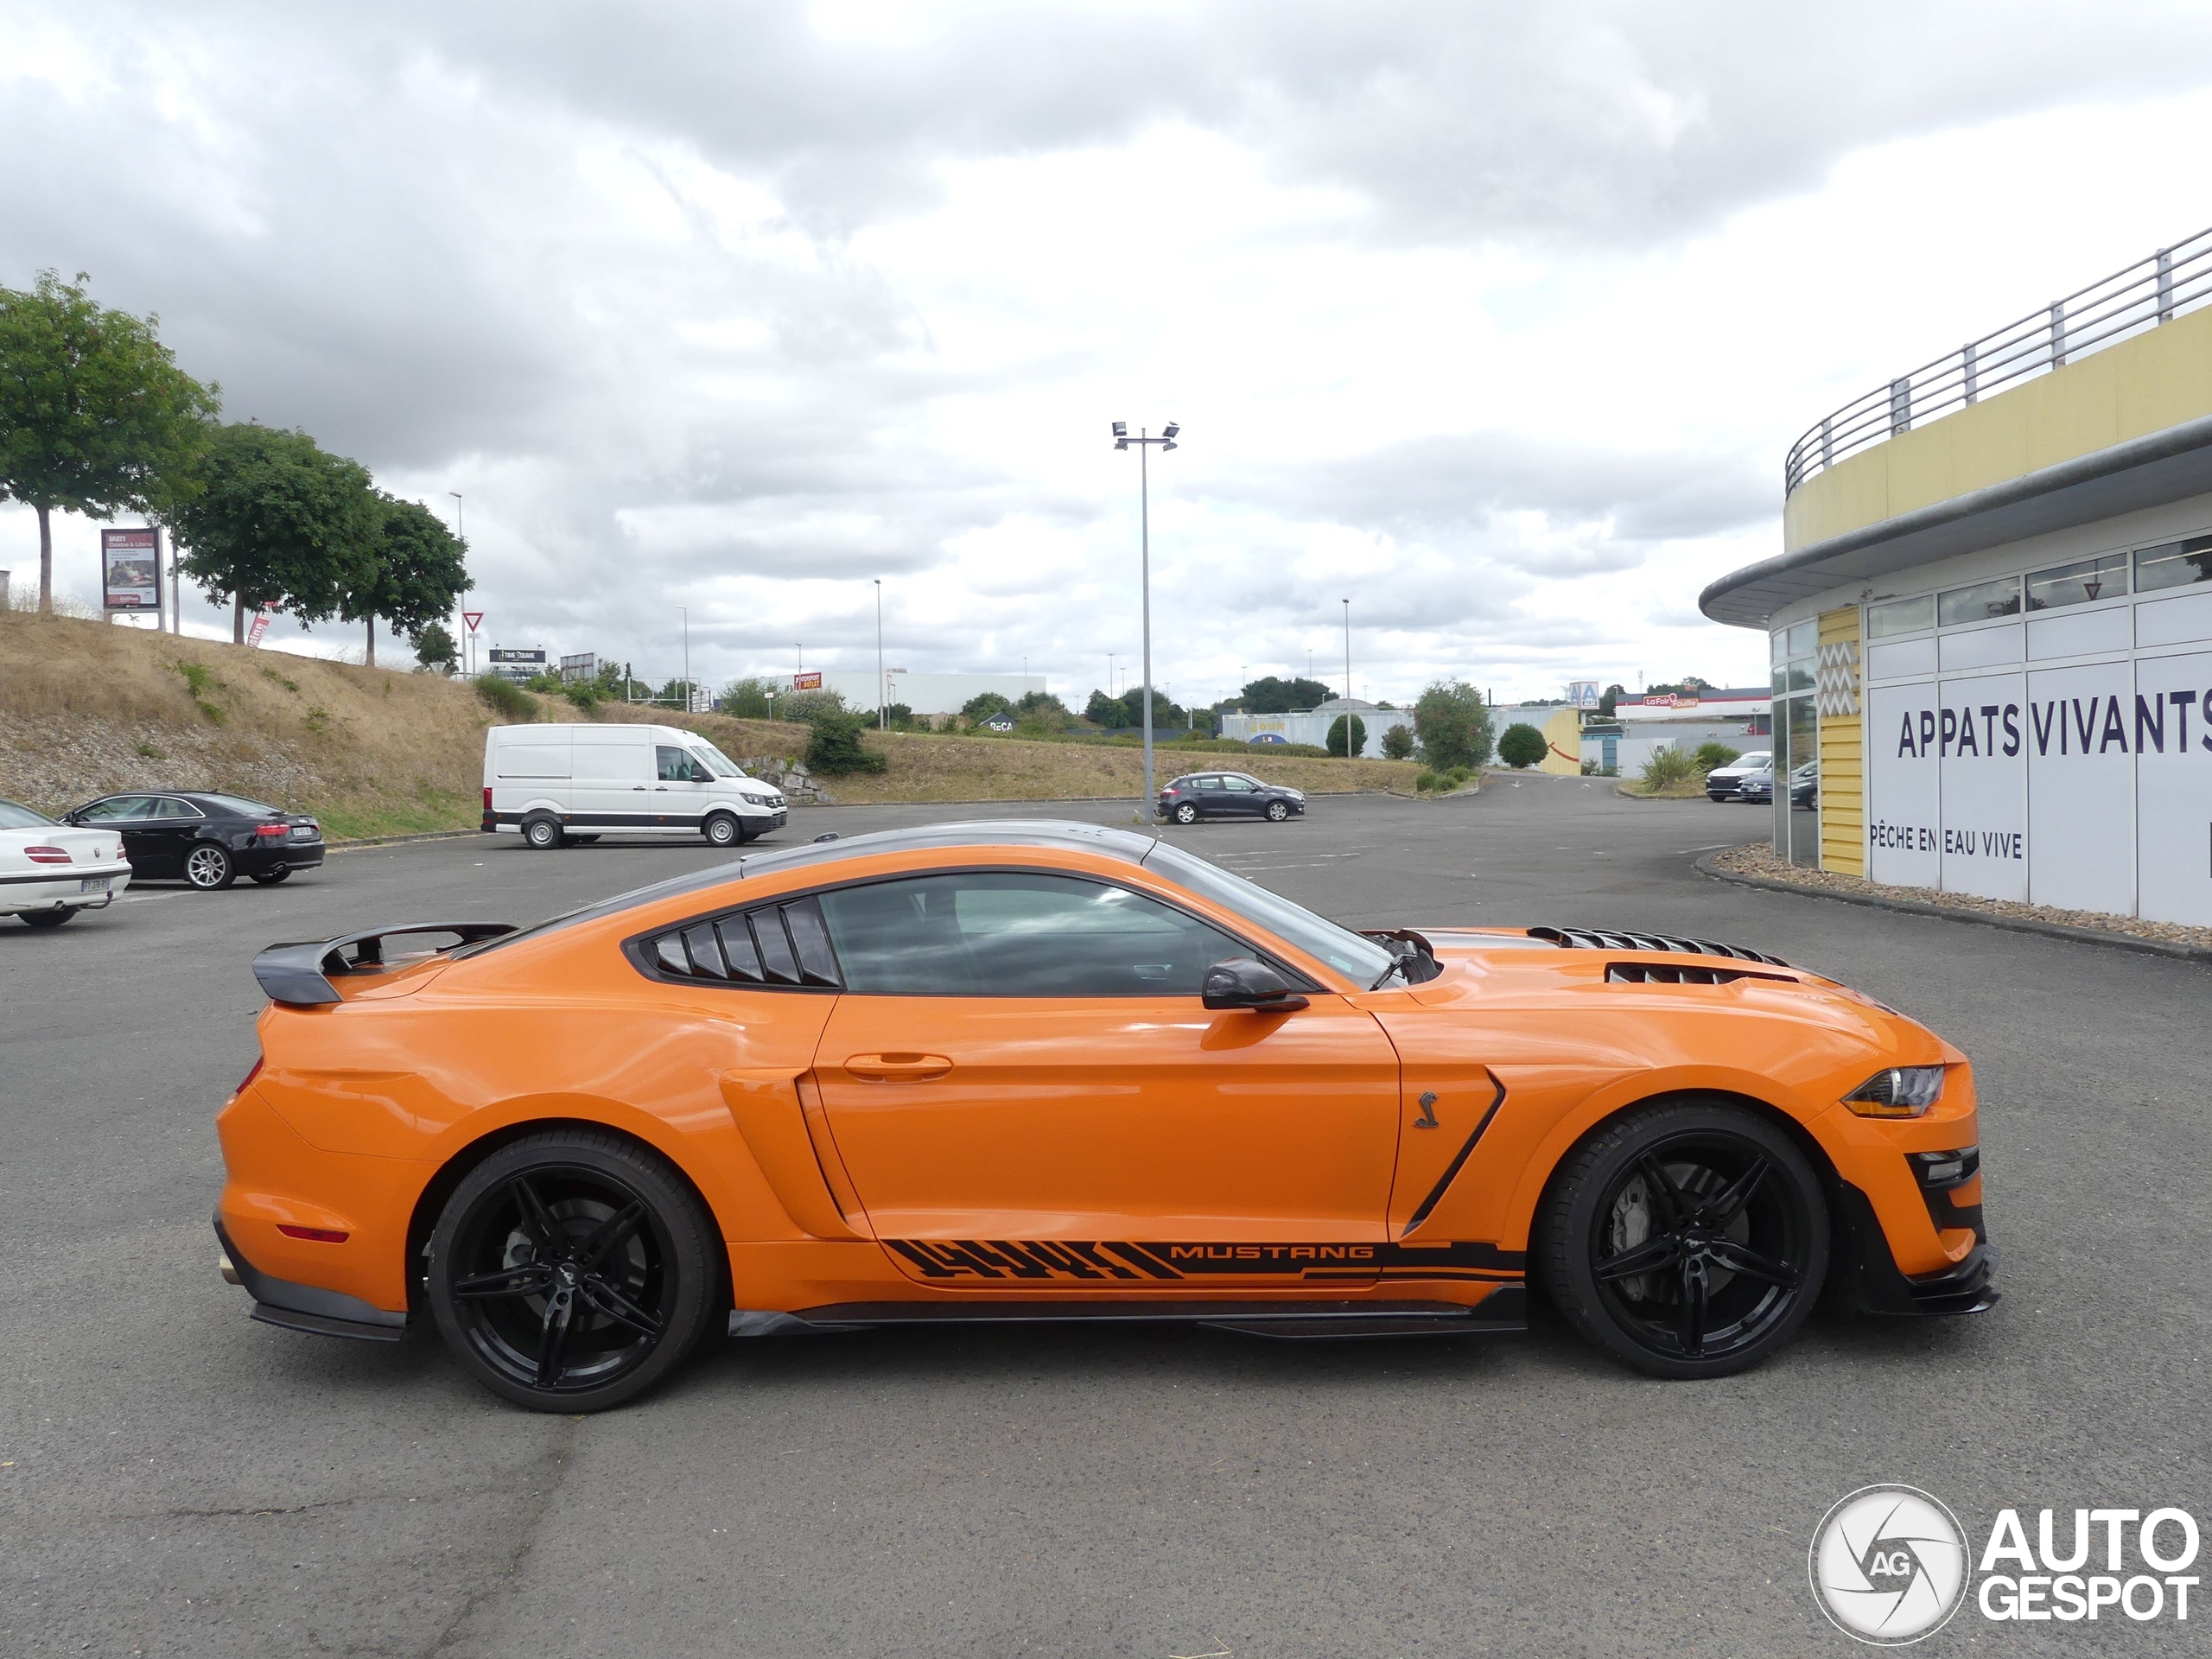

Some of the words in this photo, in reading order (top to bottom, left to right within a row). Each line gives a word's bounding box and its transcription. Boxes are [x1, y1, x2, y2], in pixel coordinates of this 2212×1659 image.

[1897, 703, 2020, 758] APPATS
[1871, 819, 1913, 849] PÊCHE
[1919, 828, 1936, 852] EN
[1945, 830, 1975, 855] EAU
[1982, 831, 2022, 859] VIVE
[1171, 1246, 1374, 1259] MUSTANG
